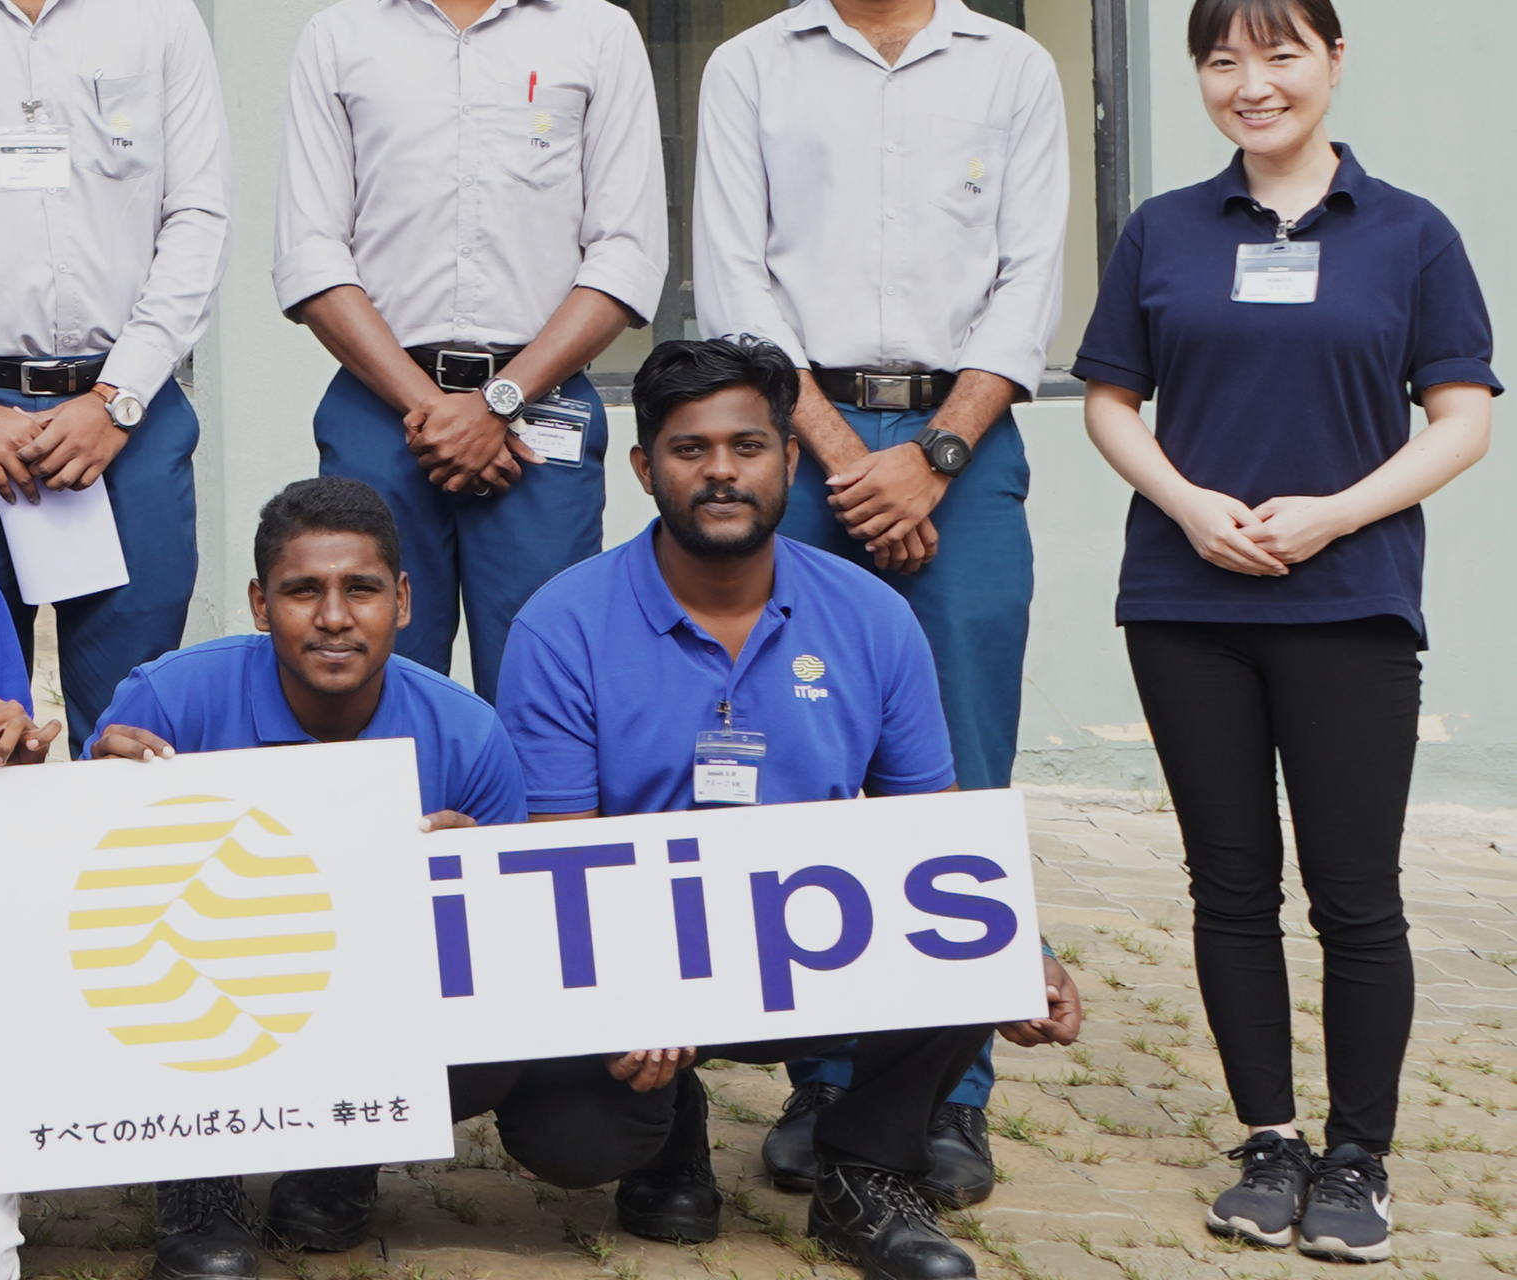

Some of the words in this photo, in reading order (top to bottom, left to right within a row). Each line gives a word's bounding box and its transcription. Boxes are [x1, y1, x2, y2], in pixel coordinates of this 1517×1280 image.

[530, 137, 550, 149] iTips
[794, 685, 829, 702] iTips
[428, 836, 1020, 1013] iTips
[29, 1095, 411, 1151] すべてのがんばる人に、幸せを
